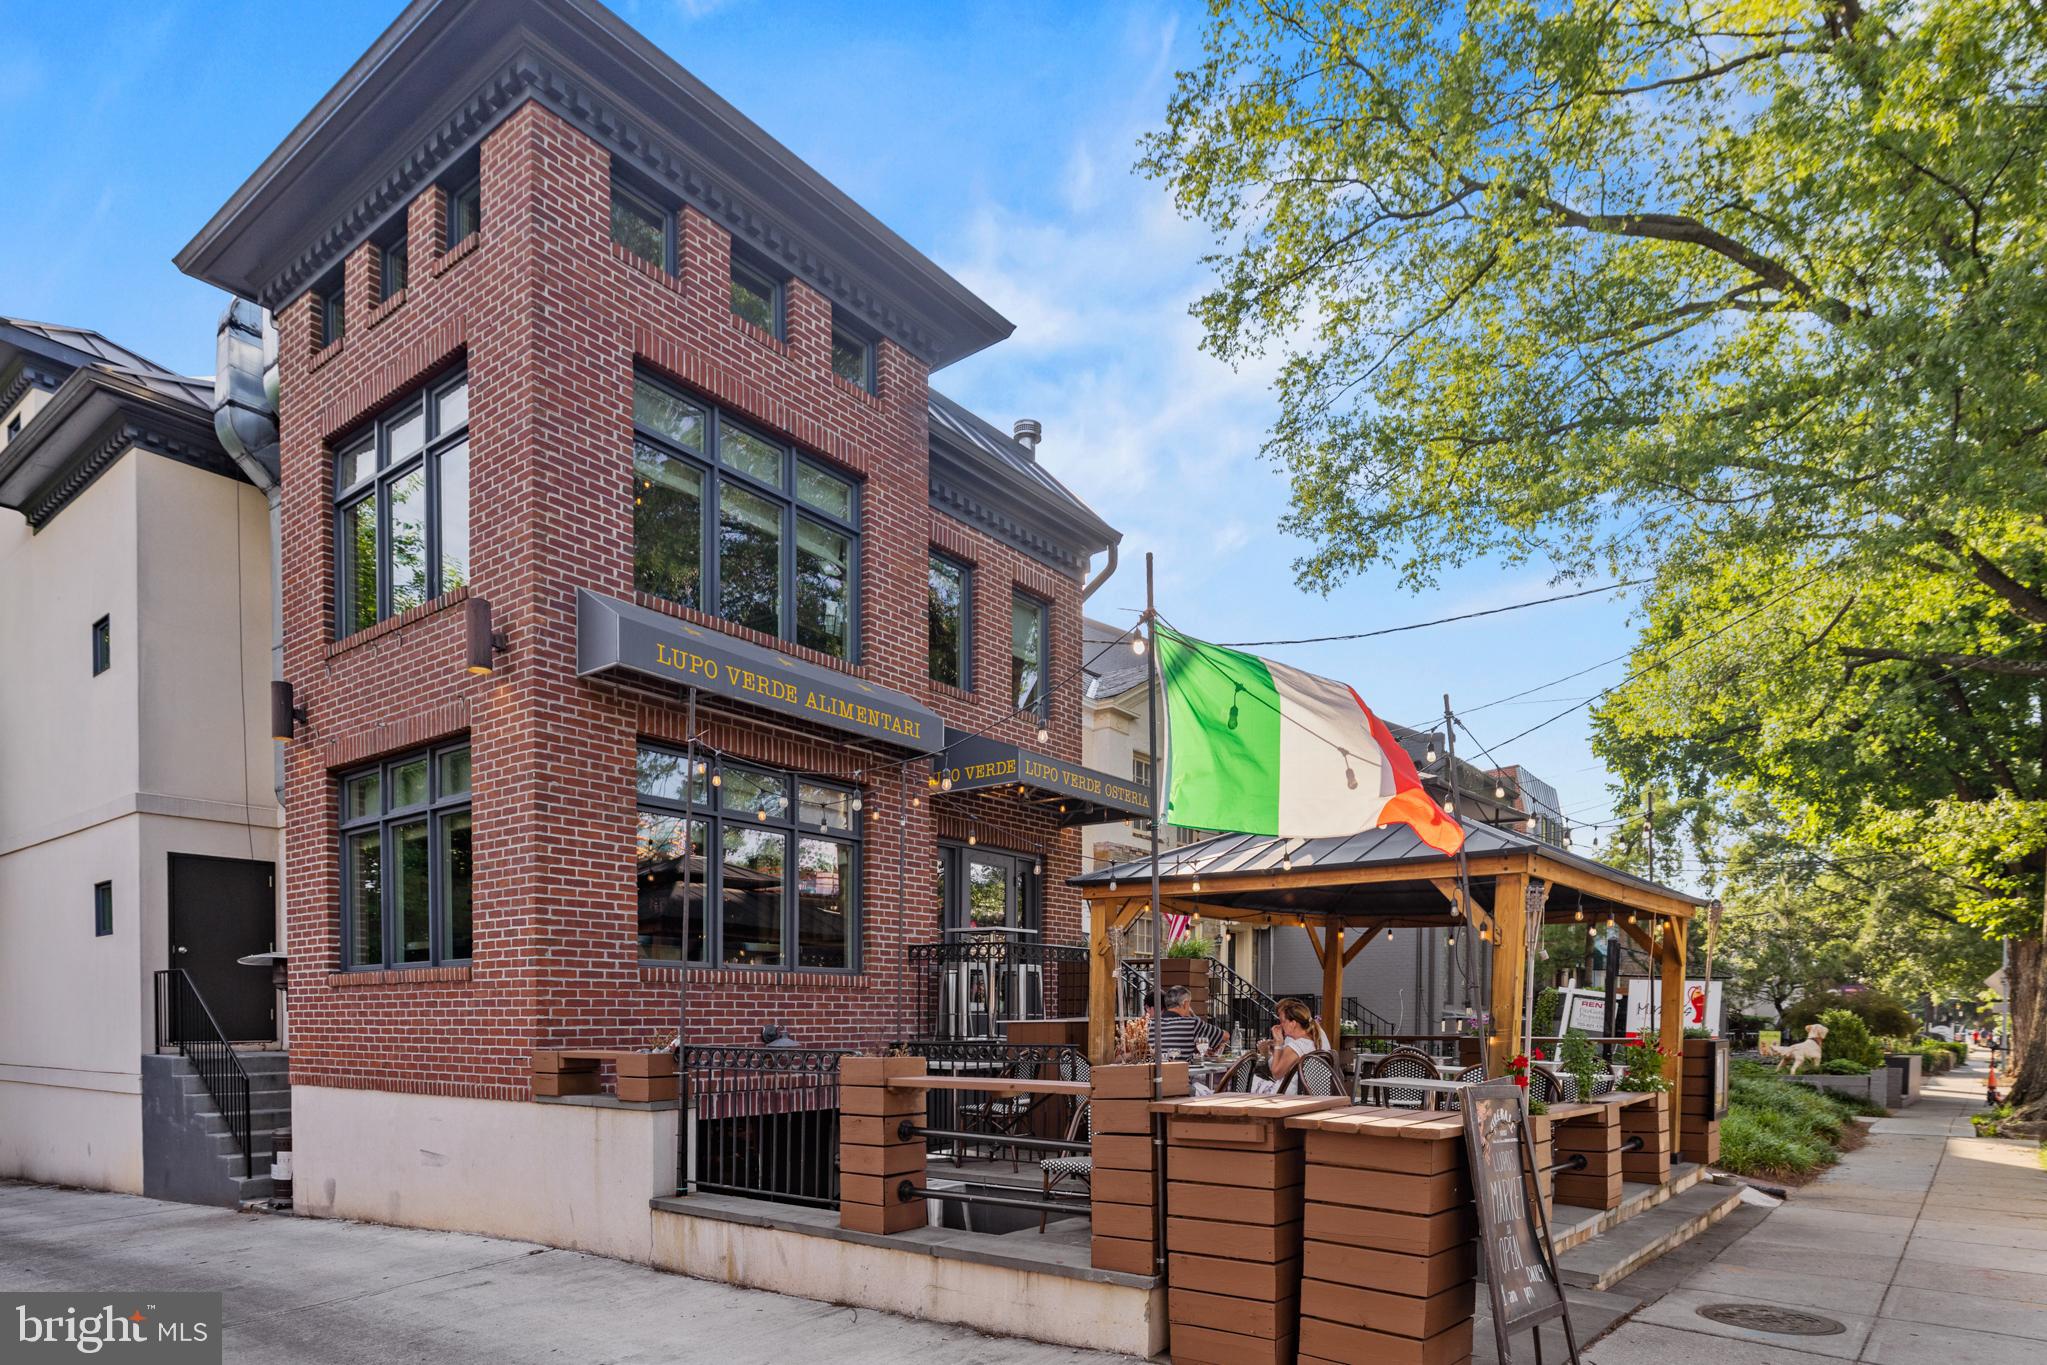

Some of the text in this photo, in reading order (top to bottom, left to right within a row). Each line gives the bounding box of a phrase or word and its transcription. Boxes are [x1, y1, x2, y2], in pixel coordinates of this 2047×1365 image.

[656, 643, 921, 739] LUPO VERDE ALIMENTARI
[965, 760, 1016, 780] VERDE
[1025, 759, 1149, 808] LUPO VERDE OSTERIA
[1581, 1000, 1605, 1009] REN
[1490, 1176, 1525, 1225] MARKET
[1499, 1235, 1523, 1274] OPEN
